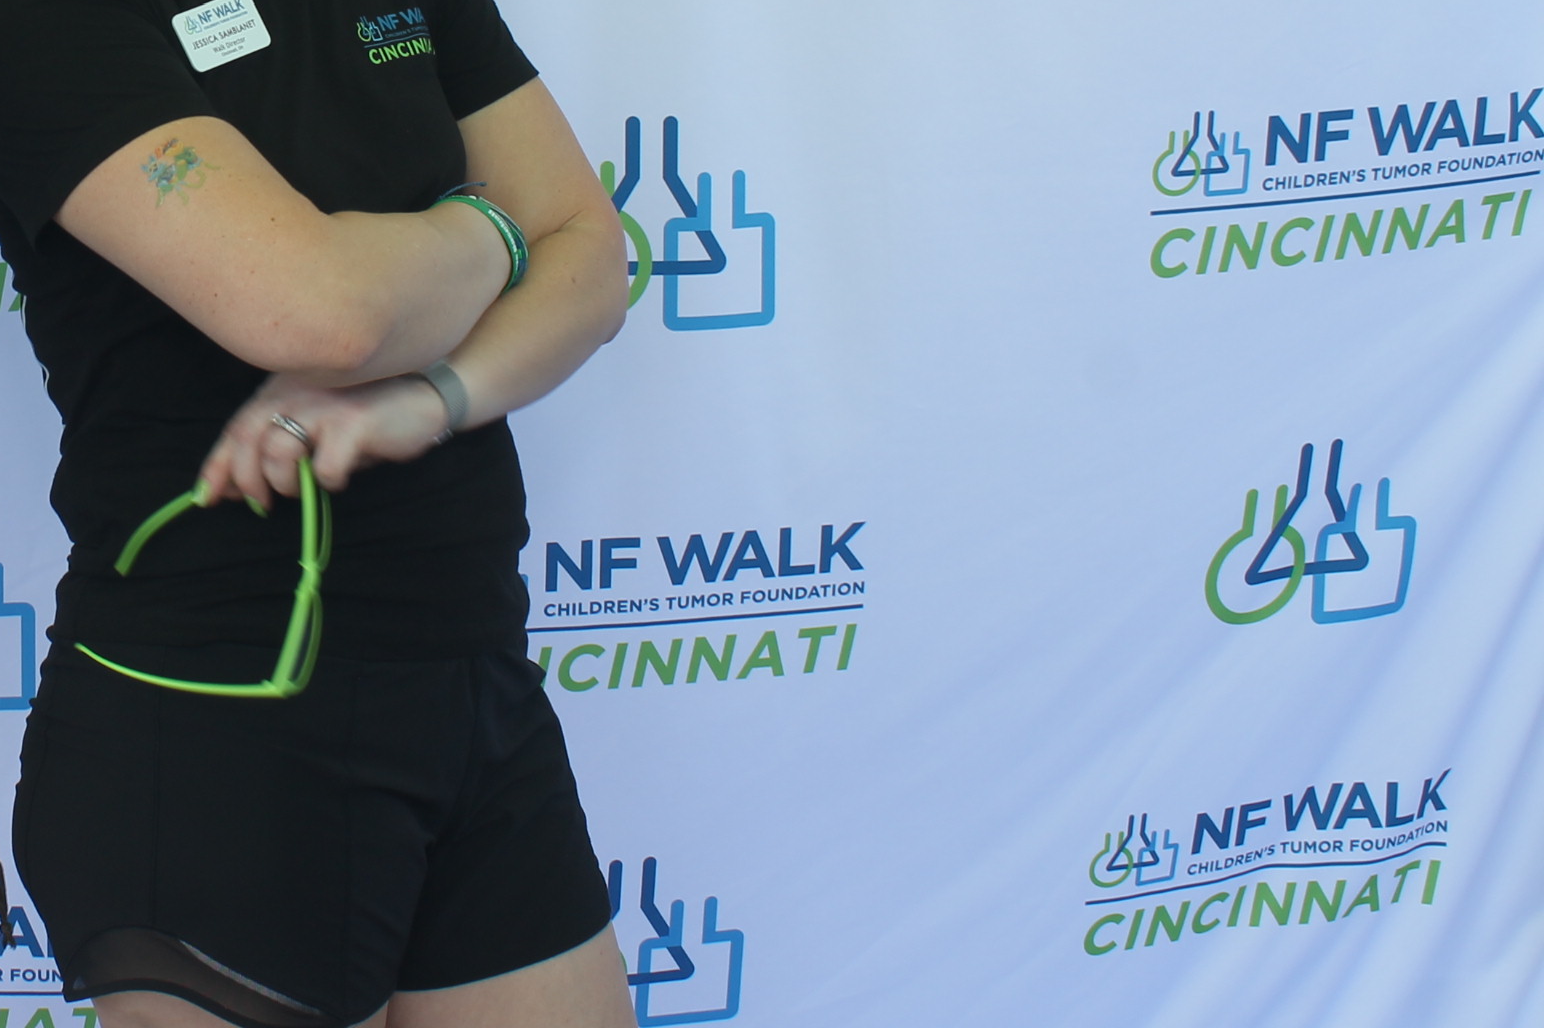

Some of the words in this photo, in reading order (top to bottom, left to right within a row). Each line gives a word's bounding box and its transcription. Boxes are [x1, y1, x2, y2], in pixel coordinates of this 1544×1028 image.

[192, 36, 219, 51] JESSICA
[197, 10, 213, 25] NF
[376, 13, 399, 32] NF
[1264, 109, 1354, 166] NF
[1367, 87, 1544, 156] WALK
[1262, 170, 1366, 192] CHILDREN'S
[1371, 163, 1432, 182] TUMOR
[1436, 149, 1544, 176] FOUNDATION
[1150, 188, 1533, 279] CINCINNATI
[544, 536, 642, 593] NF
[655, 521, 867, 586] WALK
[543, 597, 660, 617] CHILDREN'S
[665, 592, 734, 611] TUMOR
[739, 581, 866, 605] FOUNDATION
[1190, 798, 1272, 855] NF
[1283, 767, 1452, 832] WALK
[1186, 843, 1275, 876] CHILDREN'S
[1279, 840, 1344, 855] TUMOR
[1349, 820, 1449, 853] FOUNDATION
[1083, 859, 1442, 957] CINCINNATI
